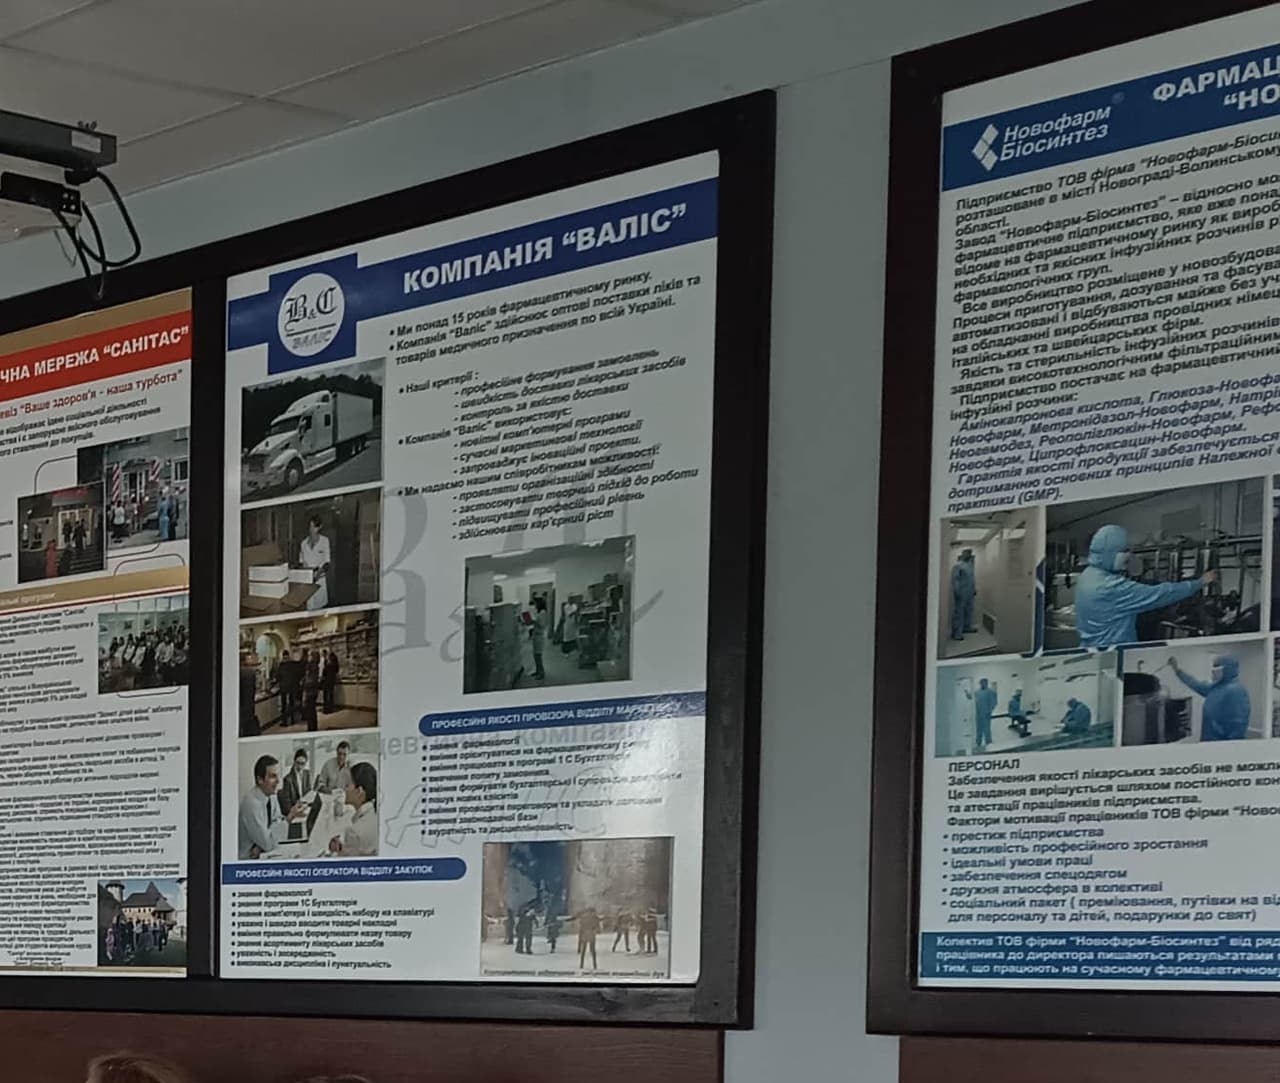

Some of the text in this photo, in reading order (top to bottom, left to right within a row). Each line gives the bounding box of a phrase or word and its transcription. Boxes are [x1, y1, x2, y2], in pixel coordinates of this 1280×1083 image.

[1000, 124, 1109, 161] Біосинтез
[1004, 106, 1111, 142] Новофарм
[955, 181, 1053, 210] Підприємство
[1058, 171, 1086, 188] ТОВ
[1090, 163, 1135, 183] фірма
[955, 196, 1045, 226] розташоване
[1048, 193, 1057, 203] в
[1061, 182, 1095, 200] місті
[954, 233, 996, 250] Завод
[1182, 179, 1253, 202] відносно
[954, 216, 1009, 237] області.
[954, 232, 1064, 265] фармацевтичне
[1067, 211, 1173, 240] підприємство,
[1177, 204, 1203, 217] яке
[1206, 197, 1236, 211] вже
[403, 202, 686, 294] КОМПАНІЯ “ВАЛІС”
[953, 218, 1264, 289] необхідних та якісних інфузійних розчинів
[954, 258, 1001, 276] відоме
[1004, 255, 1020, 266] на
[1023, 227, 1158, 264] фармацевтичному
[1161, 217, 1206, 237] ринку
[1210, 213, 1228, 225] як
[953, 264, 1112, 305] фармакологічних груп.
[961, 301, 987, 314] Все
[990, 282, 1084, 308] виробництво
[1087, 267, 1165, 292] розміщене
[396, 272, 651, 336] Ми понад 15 років фармацевтичному ринку.
[396, 331, 447, 350] Компанія
[494, 309, 548, 329] здійснює
[550, 298, 590, 316] оптові
[592, 287, 650, 307] поставки
[653, 279, 683, 294] ліків
[687, 276, 700, 286] та
[395, 295, 675, 364] товарів медичного призначення по всій Україні.
[951, 317, 1203, 368] італійських та швейцарських фірм.
[34, 346, 99, 376] МЕРЕЖА
[106, 381, 133, 396] наша
[405, 370, 472, 393] Наші критерії
[405, 428, 451, 445] Компанія
[494, 407, 572, 428] використовує:
[947, 486, 1062, 513] практики (GMP).
[948, 758, 1020, 773] ПЕРСОНАЛ
[951, 827, 1104, 844] престиж підприємства
[951, 838, 1208, 855] можливість професійного зростання
[950, 853, 1093, 871] ідеальні умови праці
[950, 869, 1127, 882] забезпечення спецодягом
[949, 879, 1162, 898] дружня атмосфера в колективі
[947, 907, 1256, 925] для персоналу та дітей, подарунки до свят)
